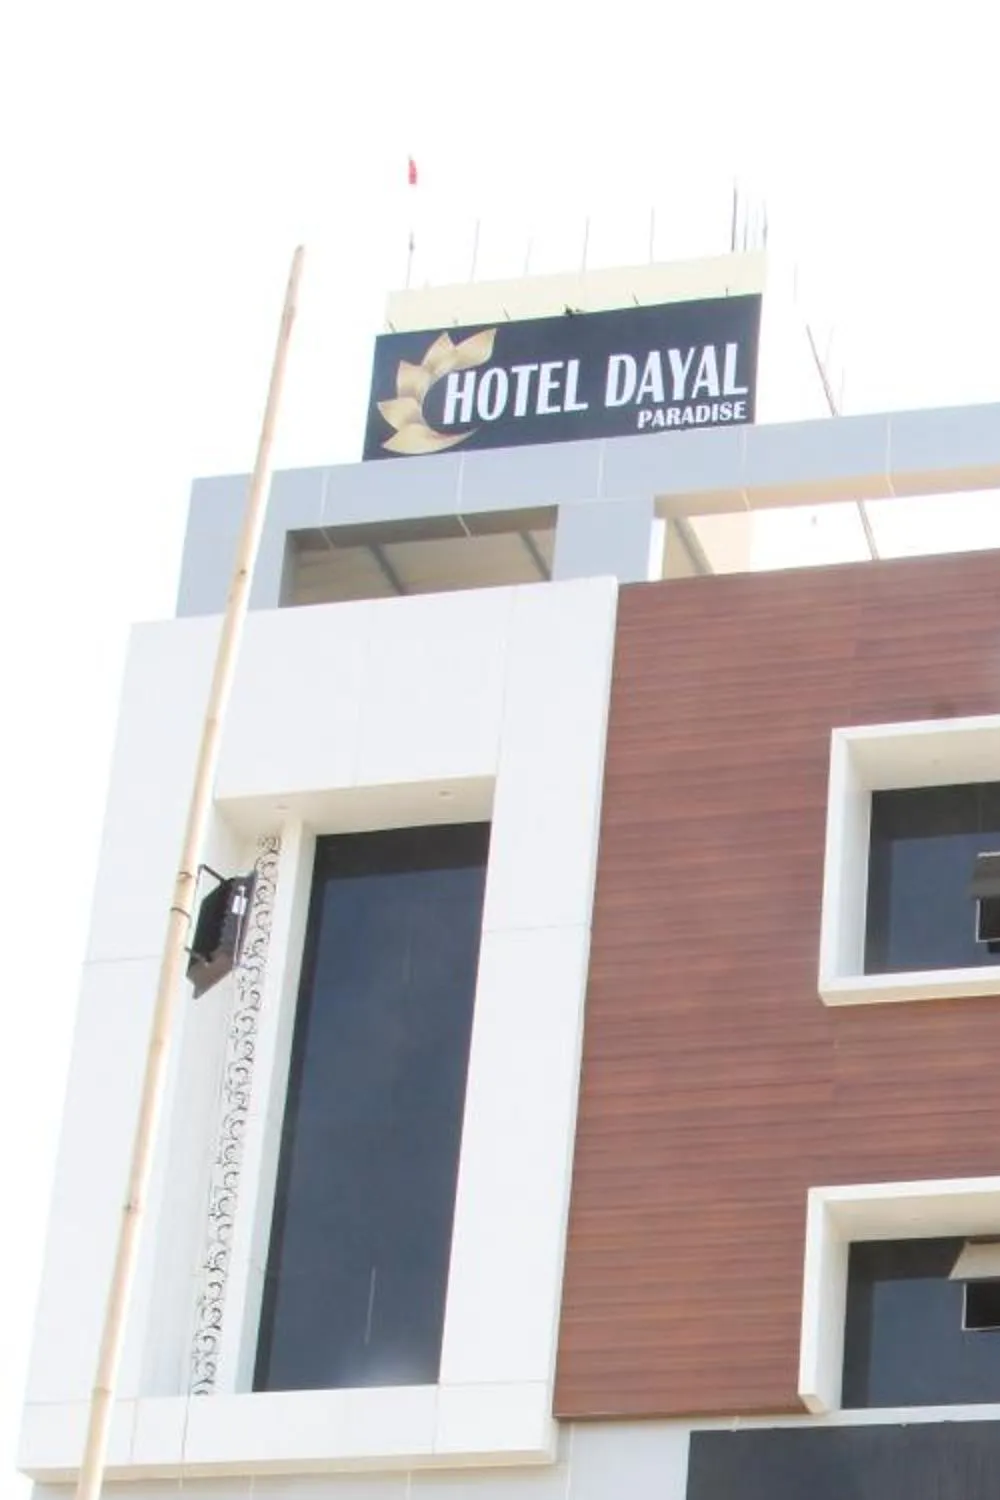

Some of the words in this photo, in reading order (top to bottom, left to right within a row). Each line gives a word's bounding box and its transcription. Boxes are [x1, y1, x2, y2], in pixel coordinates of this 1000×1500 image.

[442, 359, 589, 425] HOTEL
[604, 343, 749, 408] DAYAL
[637, 401, 747, 429] PARADISE
